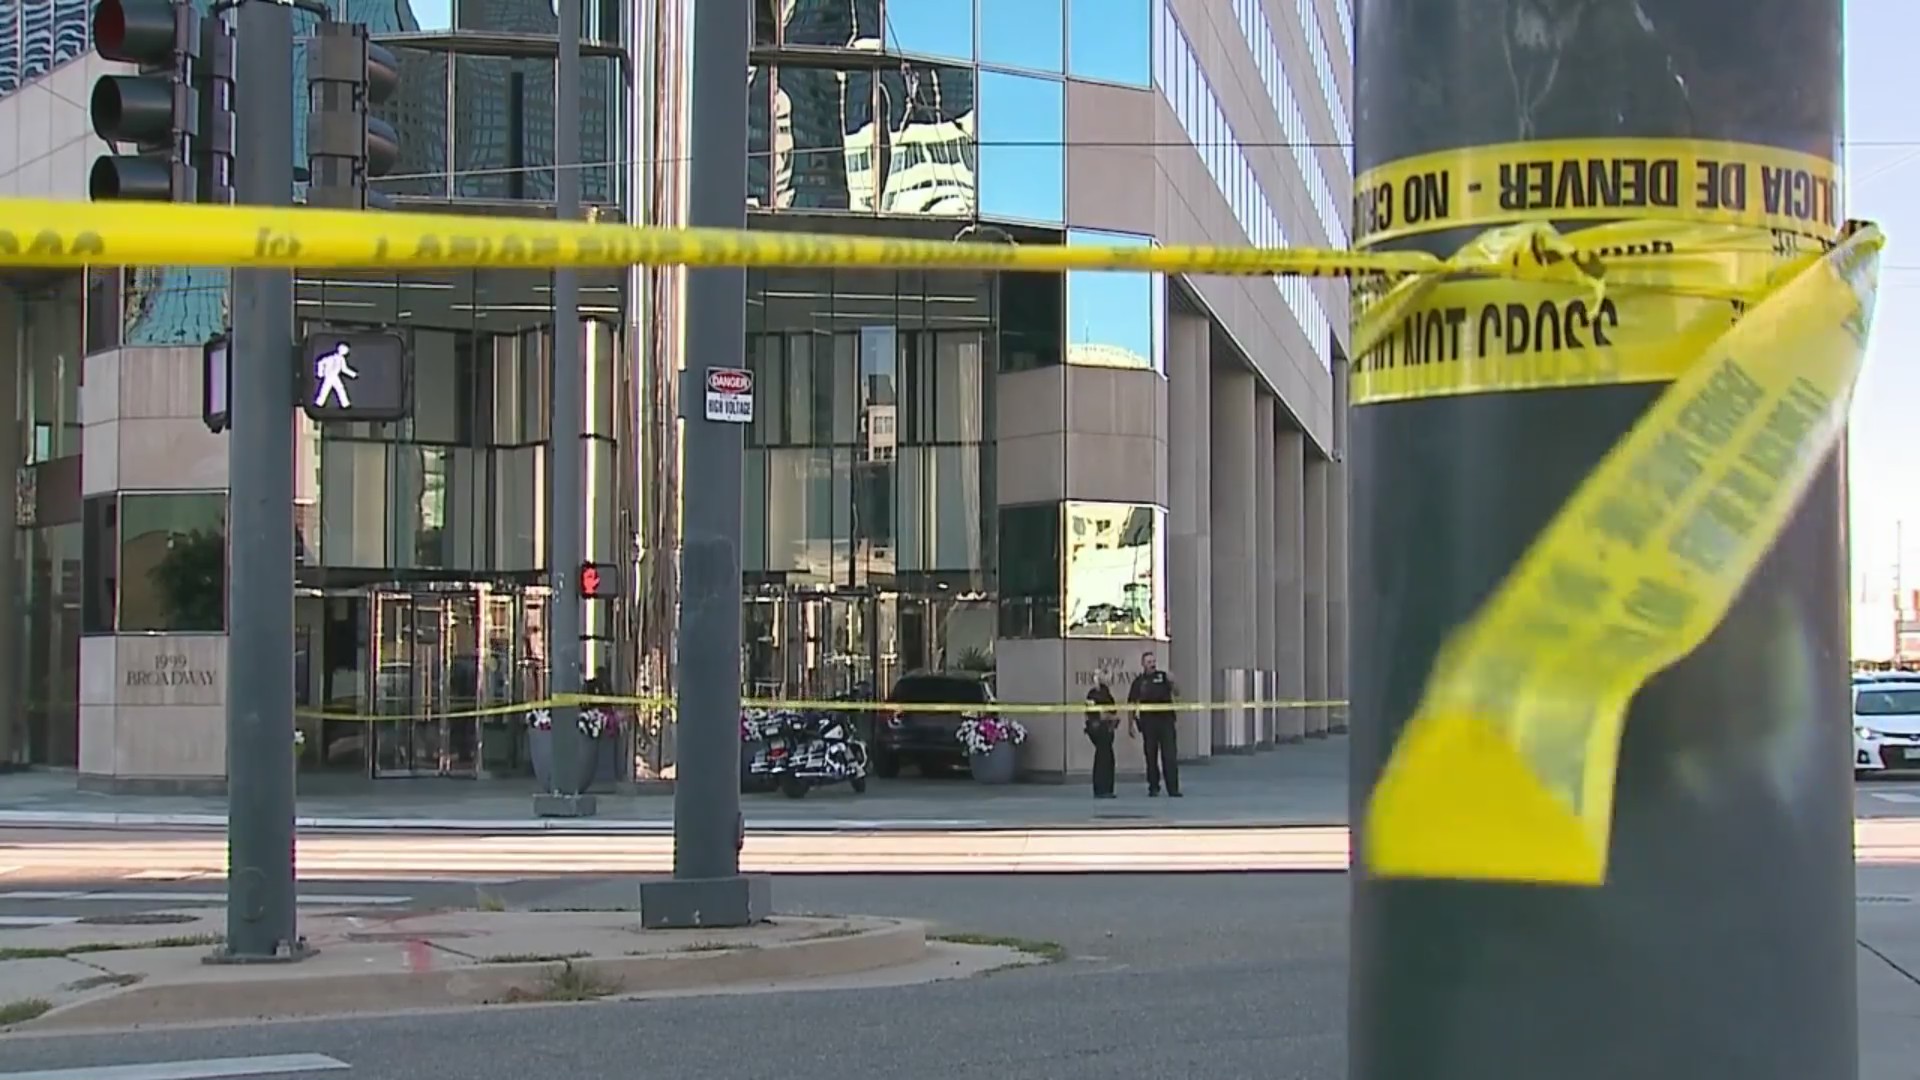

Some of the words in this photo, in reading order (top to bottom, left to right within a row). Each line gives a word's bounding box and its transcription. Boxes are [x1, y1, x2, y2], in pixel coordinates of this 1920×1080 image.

[1500, 158, 1680, 210] DENVER
[1696, 160, 1746, 212] DE
[1404, 171, 1449, 223] NO
[714, 375, 746, 388] DANGER
[708, 399, 723, 413] HIGH
[725, 401, 750, 415] VOLTAGE
[155, 655, 187, 669] 1999
[126, 671, 217, 685] BROADWAY
